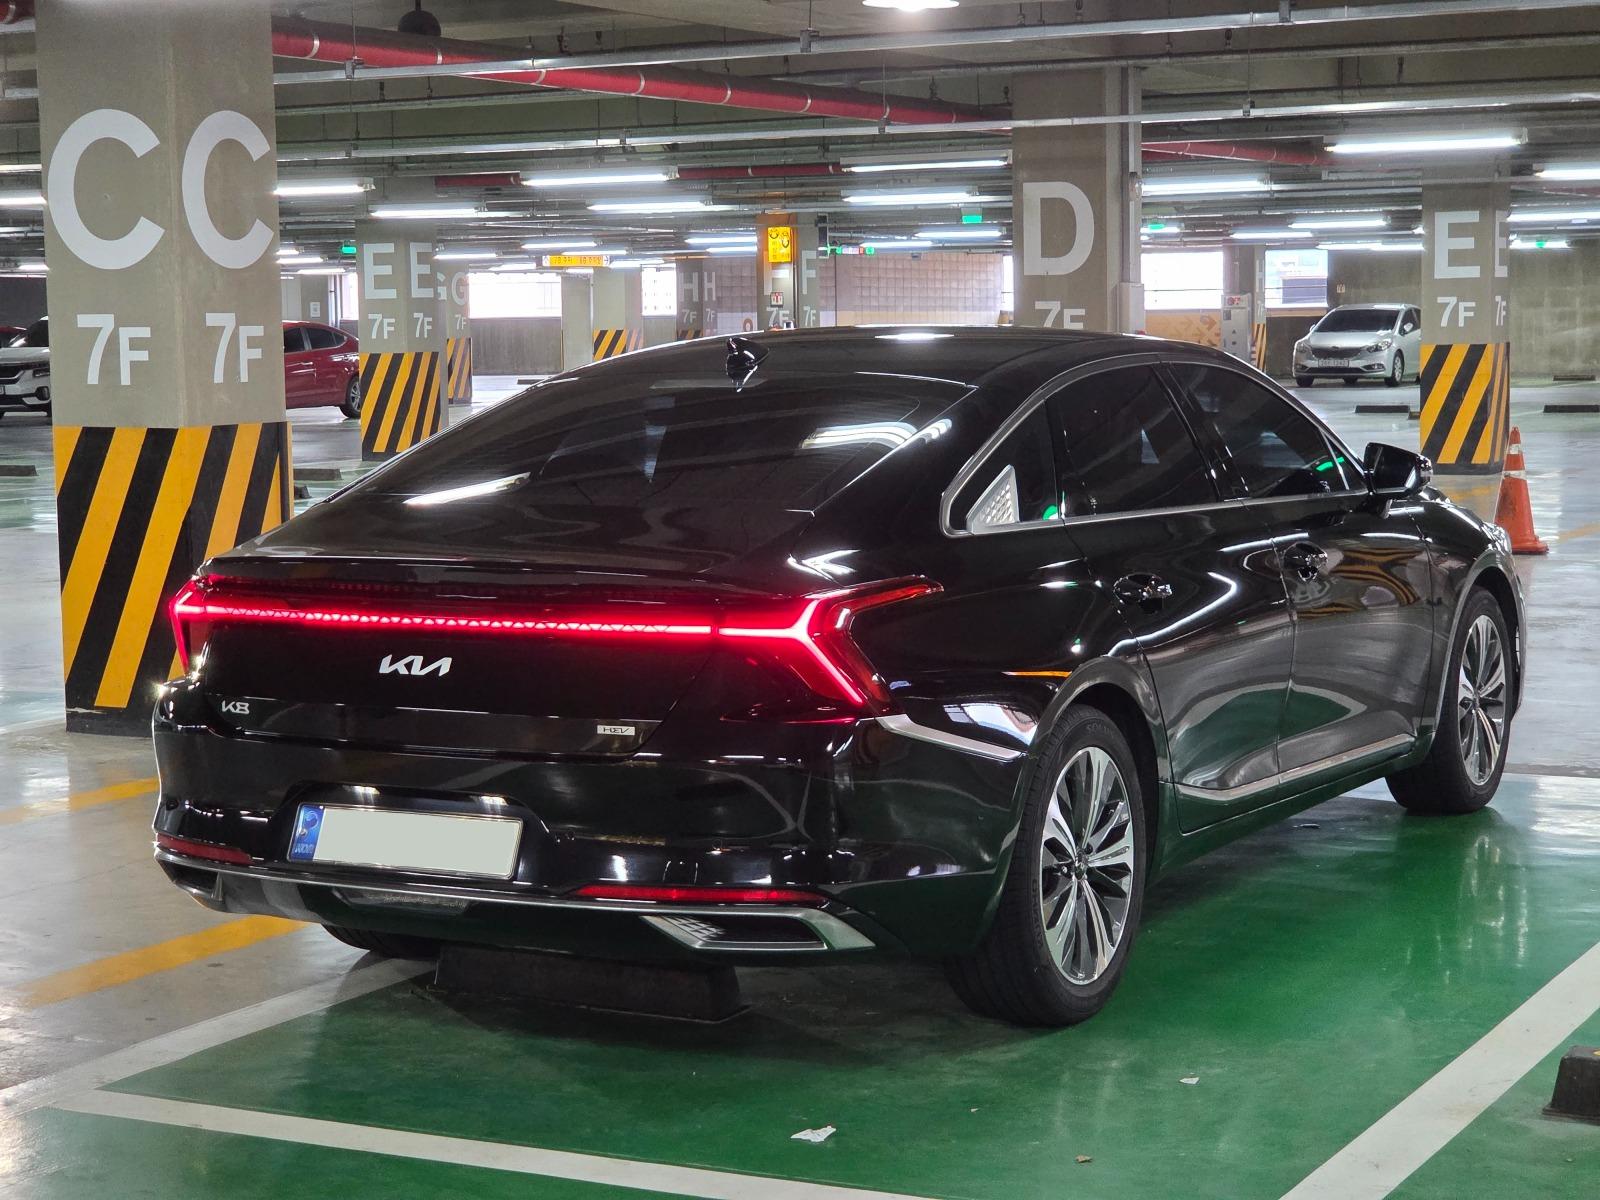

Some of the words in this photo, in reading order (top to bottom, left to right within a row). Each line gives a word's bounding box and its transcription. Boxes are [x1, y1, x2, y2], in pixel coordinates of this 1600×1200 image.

[48, 108, 165, 270] C
[181, 110, 274, 269] C
[1023, 181, 1095, 275] D
[1434, 210, 1481, 279] E
[363, 243, 397, 300] E
[409, 242, 434, 298] E
[802, 250, 817, 295] F
[680, 272, 699, 302] H
[704, 272, 716, 301] H
[368, 313, 396, 339] 7F
[413, 313, 433, 338] 7F
[455, 314, 467, 330] 7F
[682, 308, 697, 323] 7F
[706, 308, 716, 322] 7F
[804, 305, 817, 327] 7F
[1035, 301, 1086, 329] 7F
[1437, 296, 1476, 327] 7F
[77, 313, 152, 385] 7F
[206, 313, 264, 384] 7F
[379, 654, 453, 677] KIA
[221, 700, 250, 715] K8
